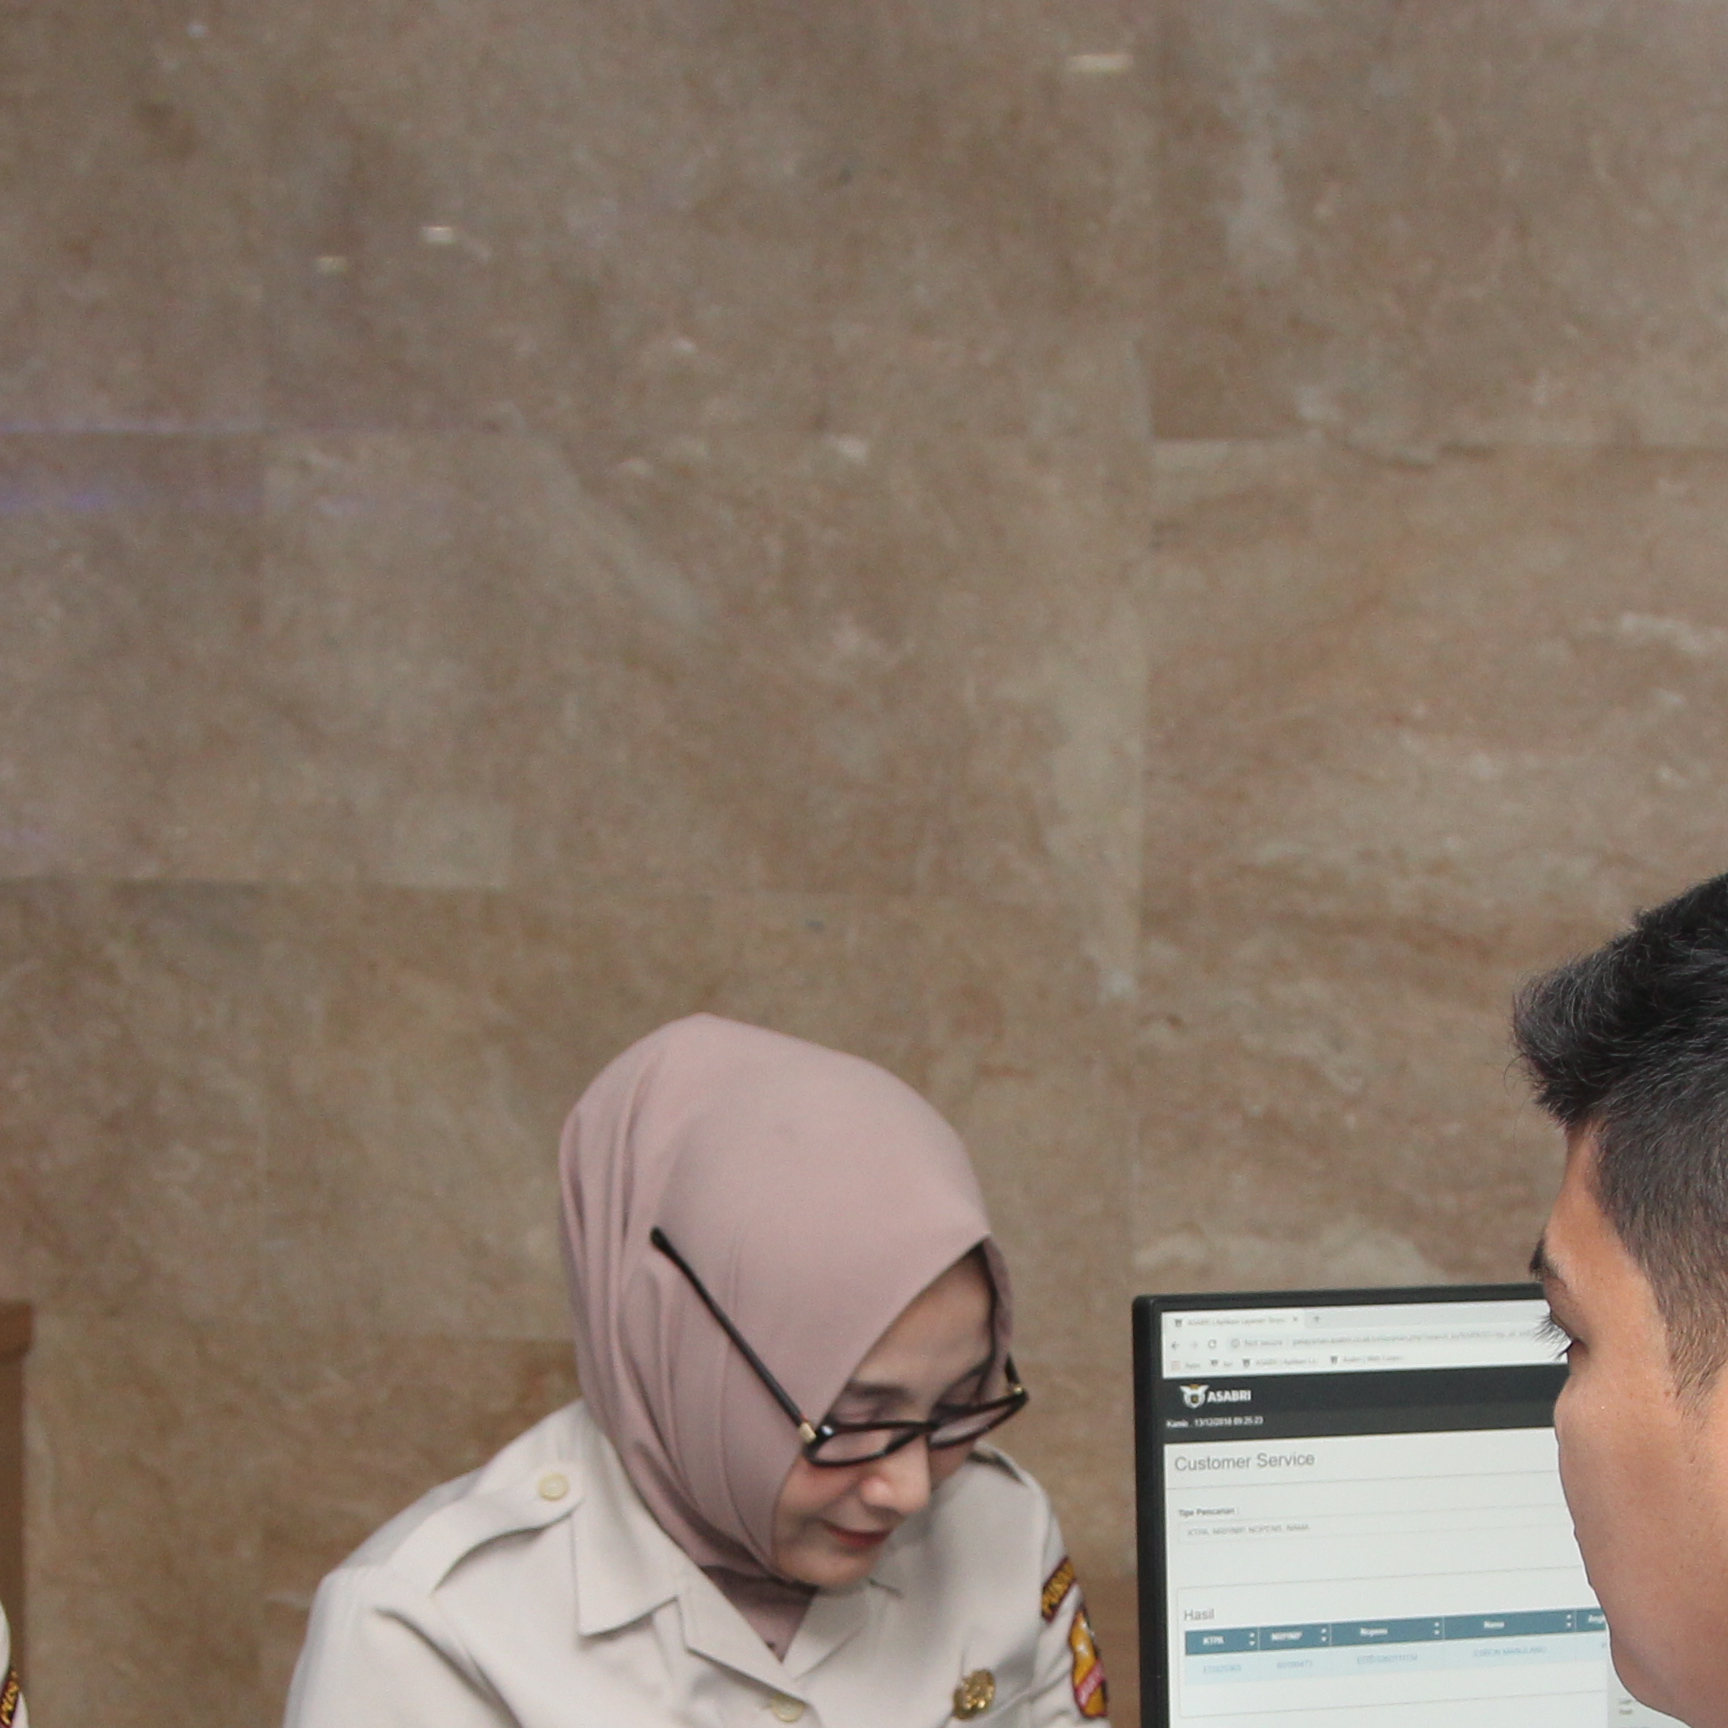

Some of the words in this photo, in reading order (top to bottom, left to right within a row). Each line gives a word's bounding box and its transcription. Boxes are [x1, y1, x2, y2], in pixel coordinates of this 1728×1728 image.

[1207, 1388, 1251, 1403] ASABRI
[1175, 1453, 1251, 1472] Customer
[1257, 1452, 1315, 1468] Service
[1184, 1608, 1215, 1622] Hasil
